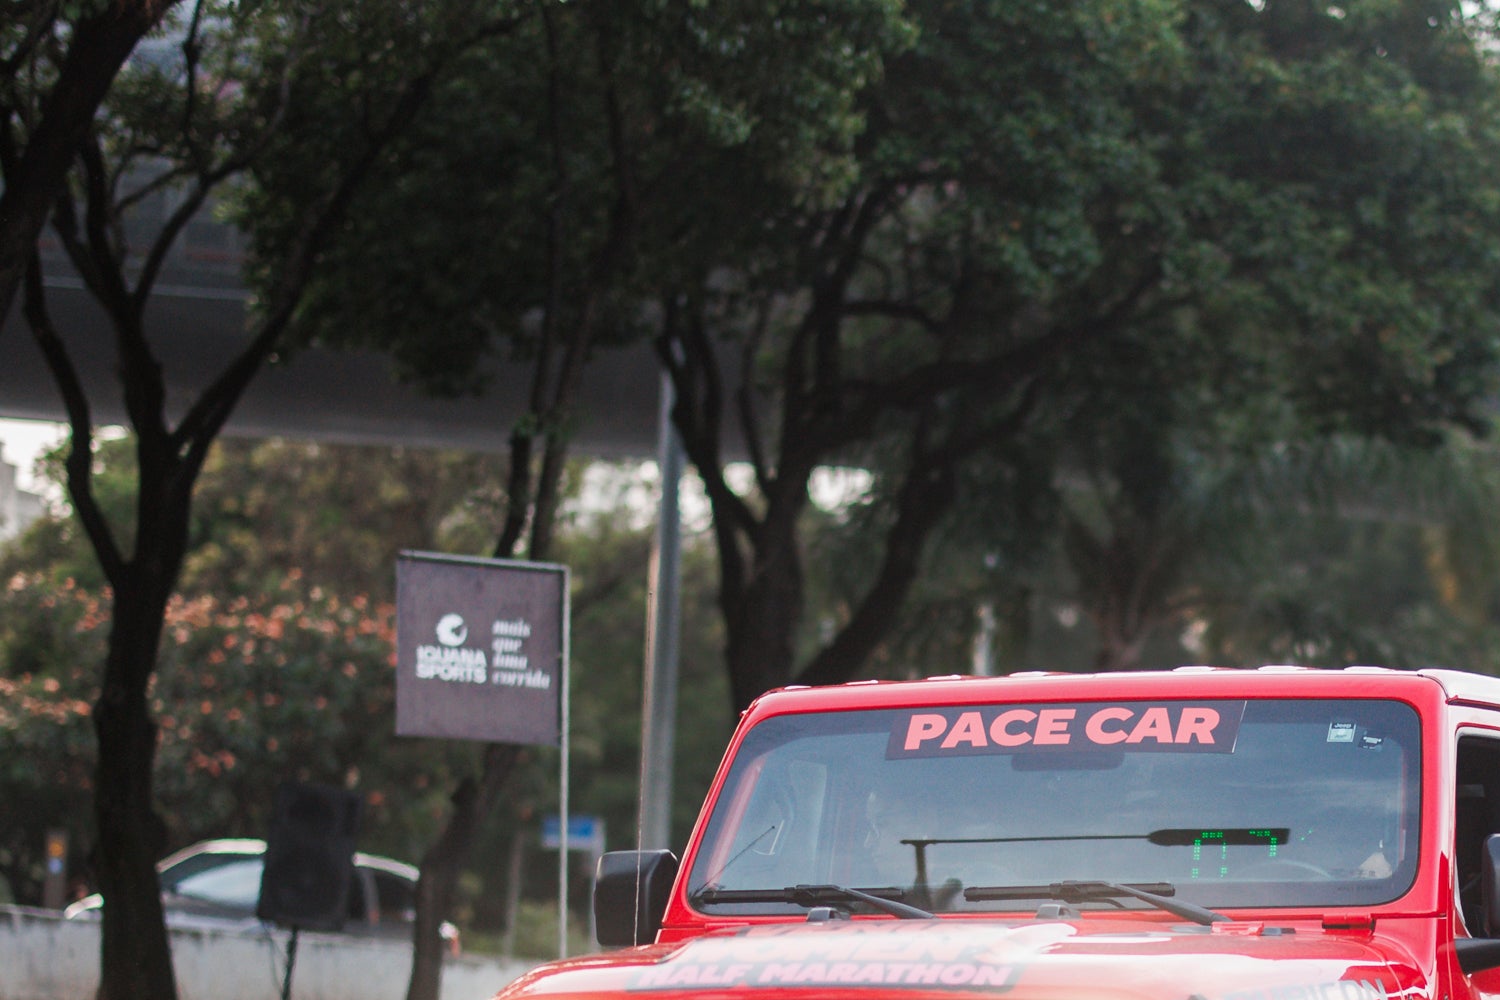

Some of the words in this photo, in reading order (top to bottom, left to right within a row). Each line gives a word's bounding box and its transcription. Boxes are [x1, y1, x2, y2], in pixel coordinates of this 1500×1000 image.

[416, 663, 487, 684] SPORTS
[904, 708, 1077, 751] PACE
[1084, 706, 1221, 746] CAR
[638, 963, 753, 987] HALF
[758, 962, 1013, 986] MARATHON
